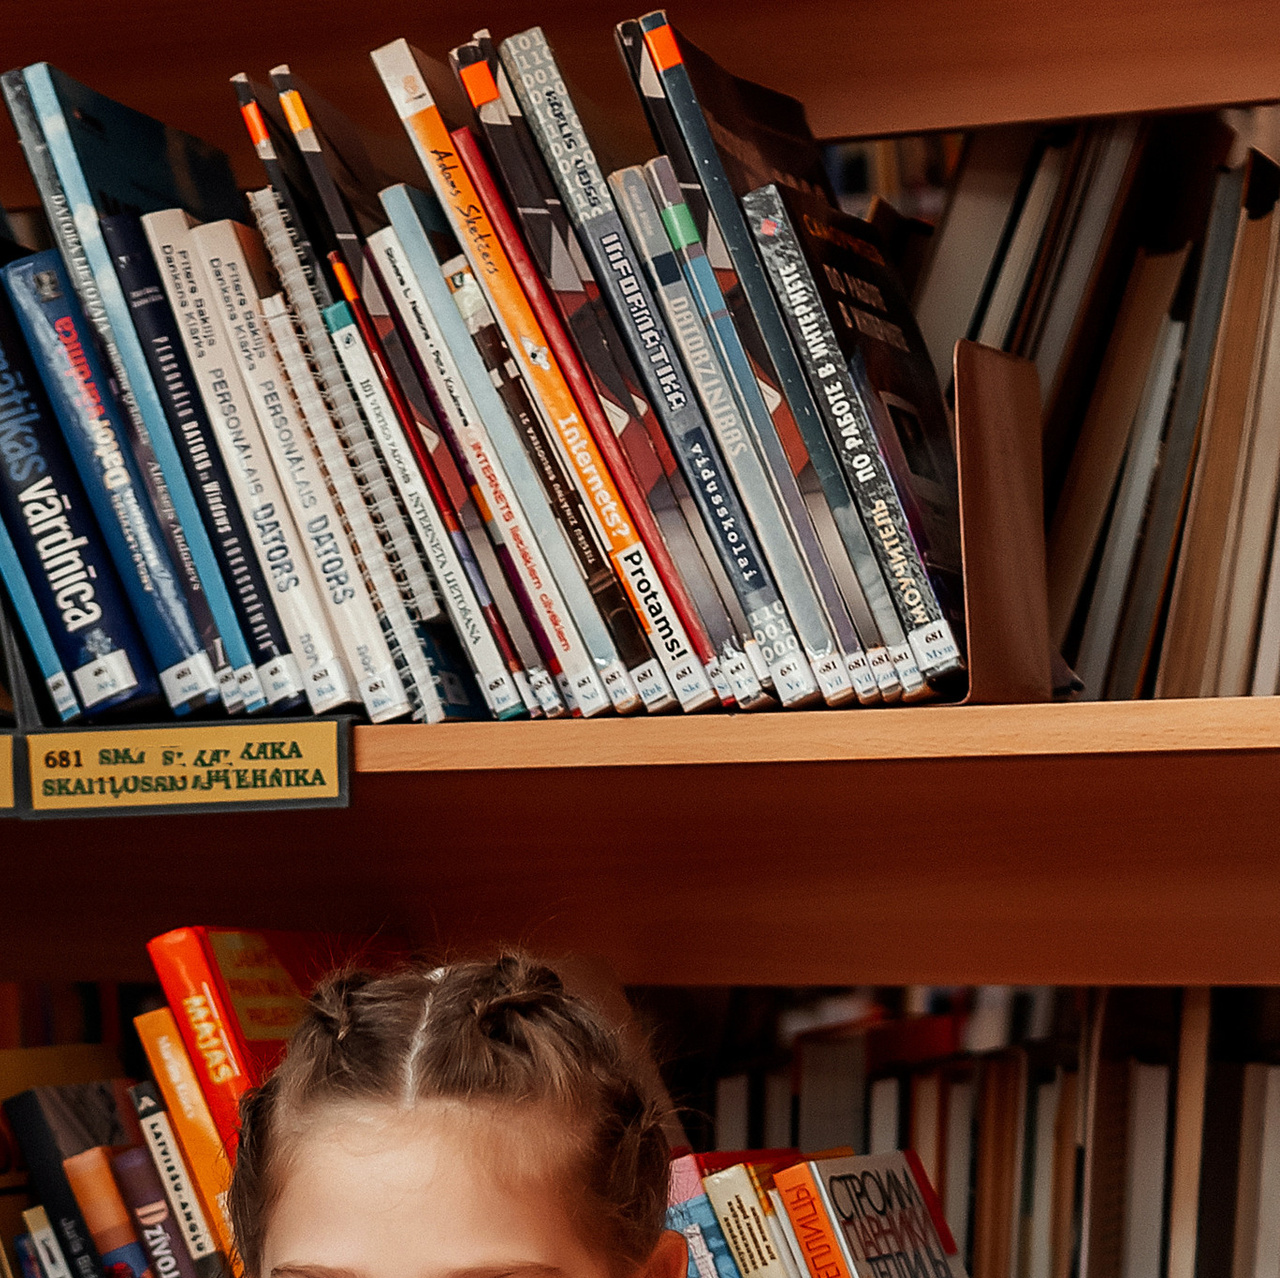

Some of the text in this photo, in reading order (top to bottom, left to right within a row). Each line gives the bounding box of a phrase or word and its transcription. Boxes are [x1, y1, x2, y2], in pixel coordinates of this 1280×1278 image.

[430, 149, 462, 198] Adams
[600, 232, 687, 413] INFORMATIKA
[823, 380, 864, 450] РАБОТЕ
[202, 480, 232, 534] Windows
[471, 441, 515, 523] INTERNETS
[558, 412, 631, 539] Internets?
[691, 442, 757, 583] vidusskolai
[852, 453, 877, 483] ПО
[18, 475, 102, 632] vārdnīca
[252, 502, 300, 593] DATORS
[307, 513, 356, 606] DATORS
[871, 499, 930, 624] МОУЧИТЕЛЬ
[623, 550, 689, 661] Protams!
[925, 630, 944, 644] 681
[44, 750, 83, 768] 681
[149, 1122, 205, 1253] LATVIEŠU-ANGĻU
[828, 1168, 923, 1221] СТРОИМ
